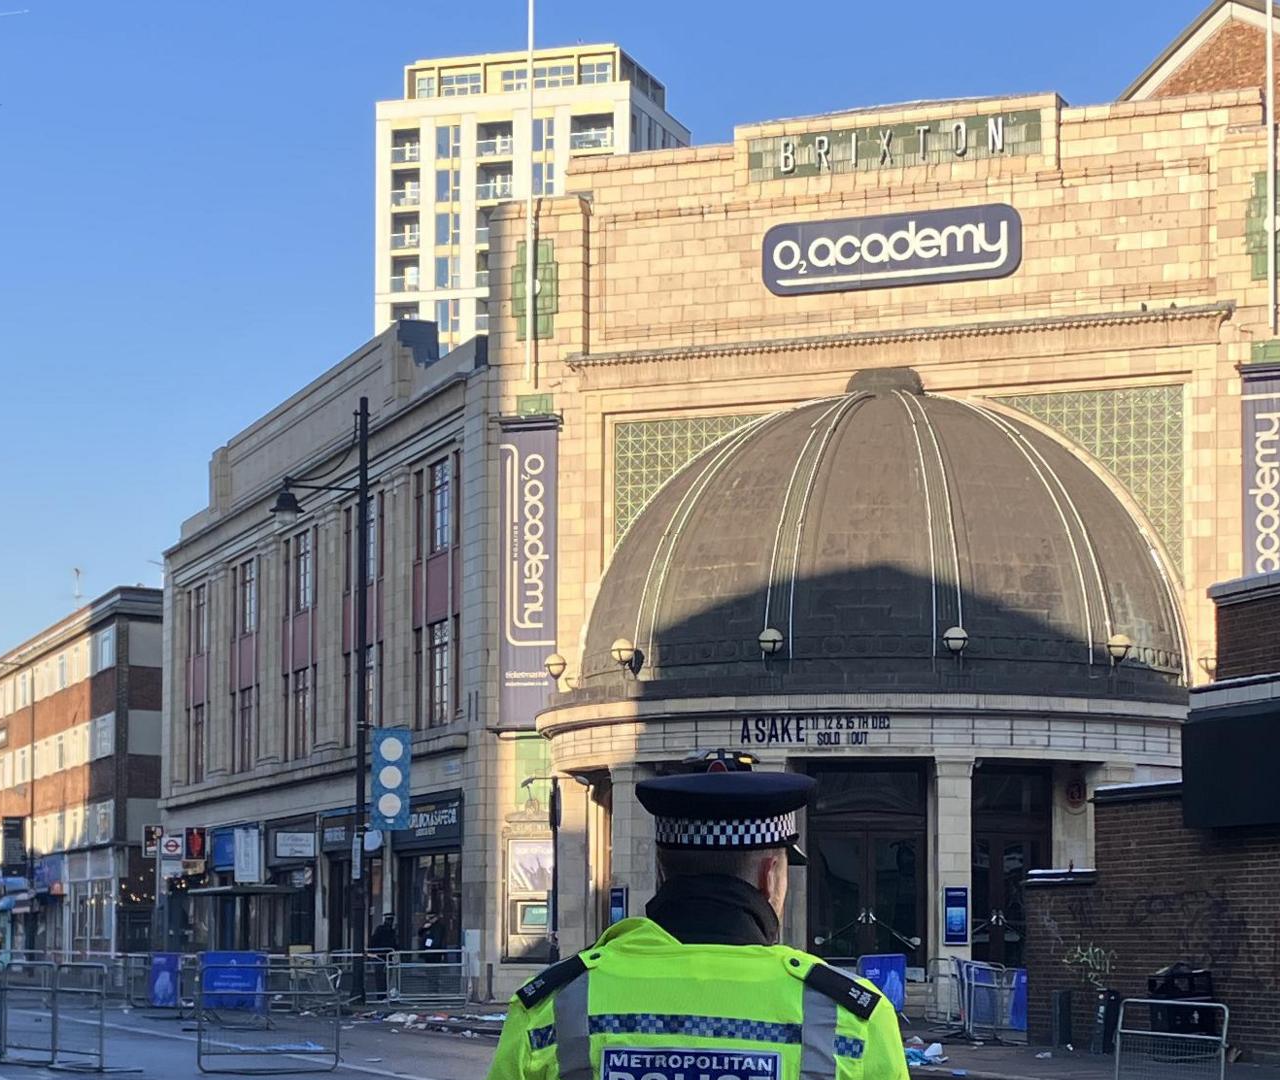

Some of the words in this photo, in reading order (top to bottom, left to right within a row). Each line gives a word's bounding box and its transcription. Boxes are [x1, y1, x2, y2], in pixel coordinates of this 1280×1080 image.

[780, 116, 1004, 174] BRIXTON
[808, 220, 1008, 268] academy
[522, 479, 549, 629] academy
[741, 716, 805, 744] ASAKE
[824, 716, 832, 730] 12
[836, 716, 843, 730] &
[817, 731, 840, 745] SOLD
[851, 731, 869, 745] OUT
[609, 1053, 772, 1071] METROPOLITAN
